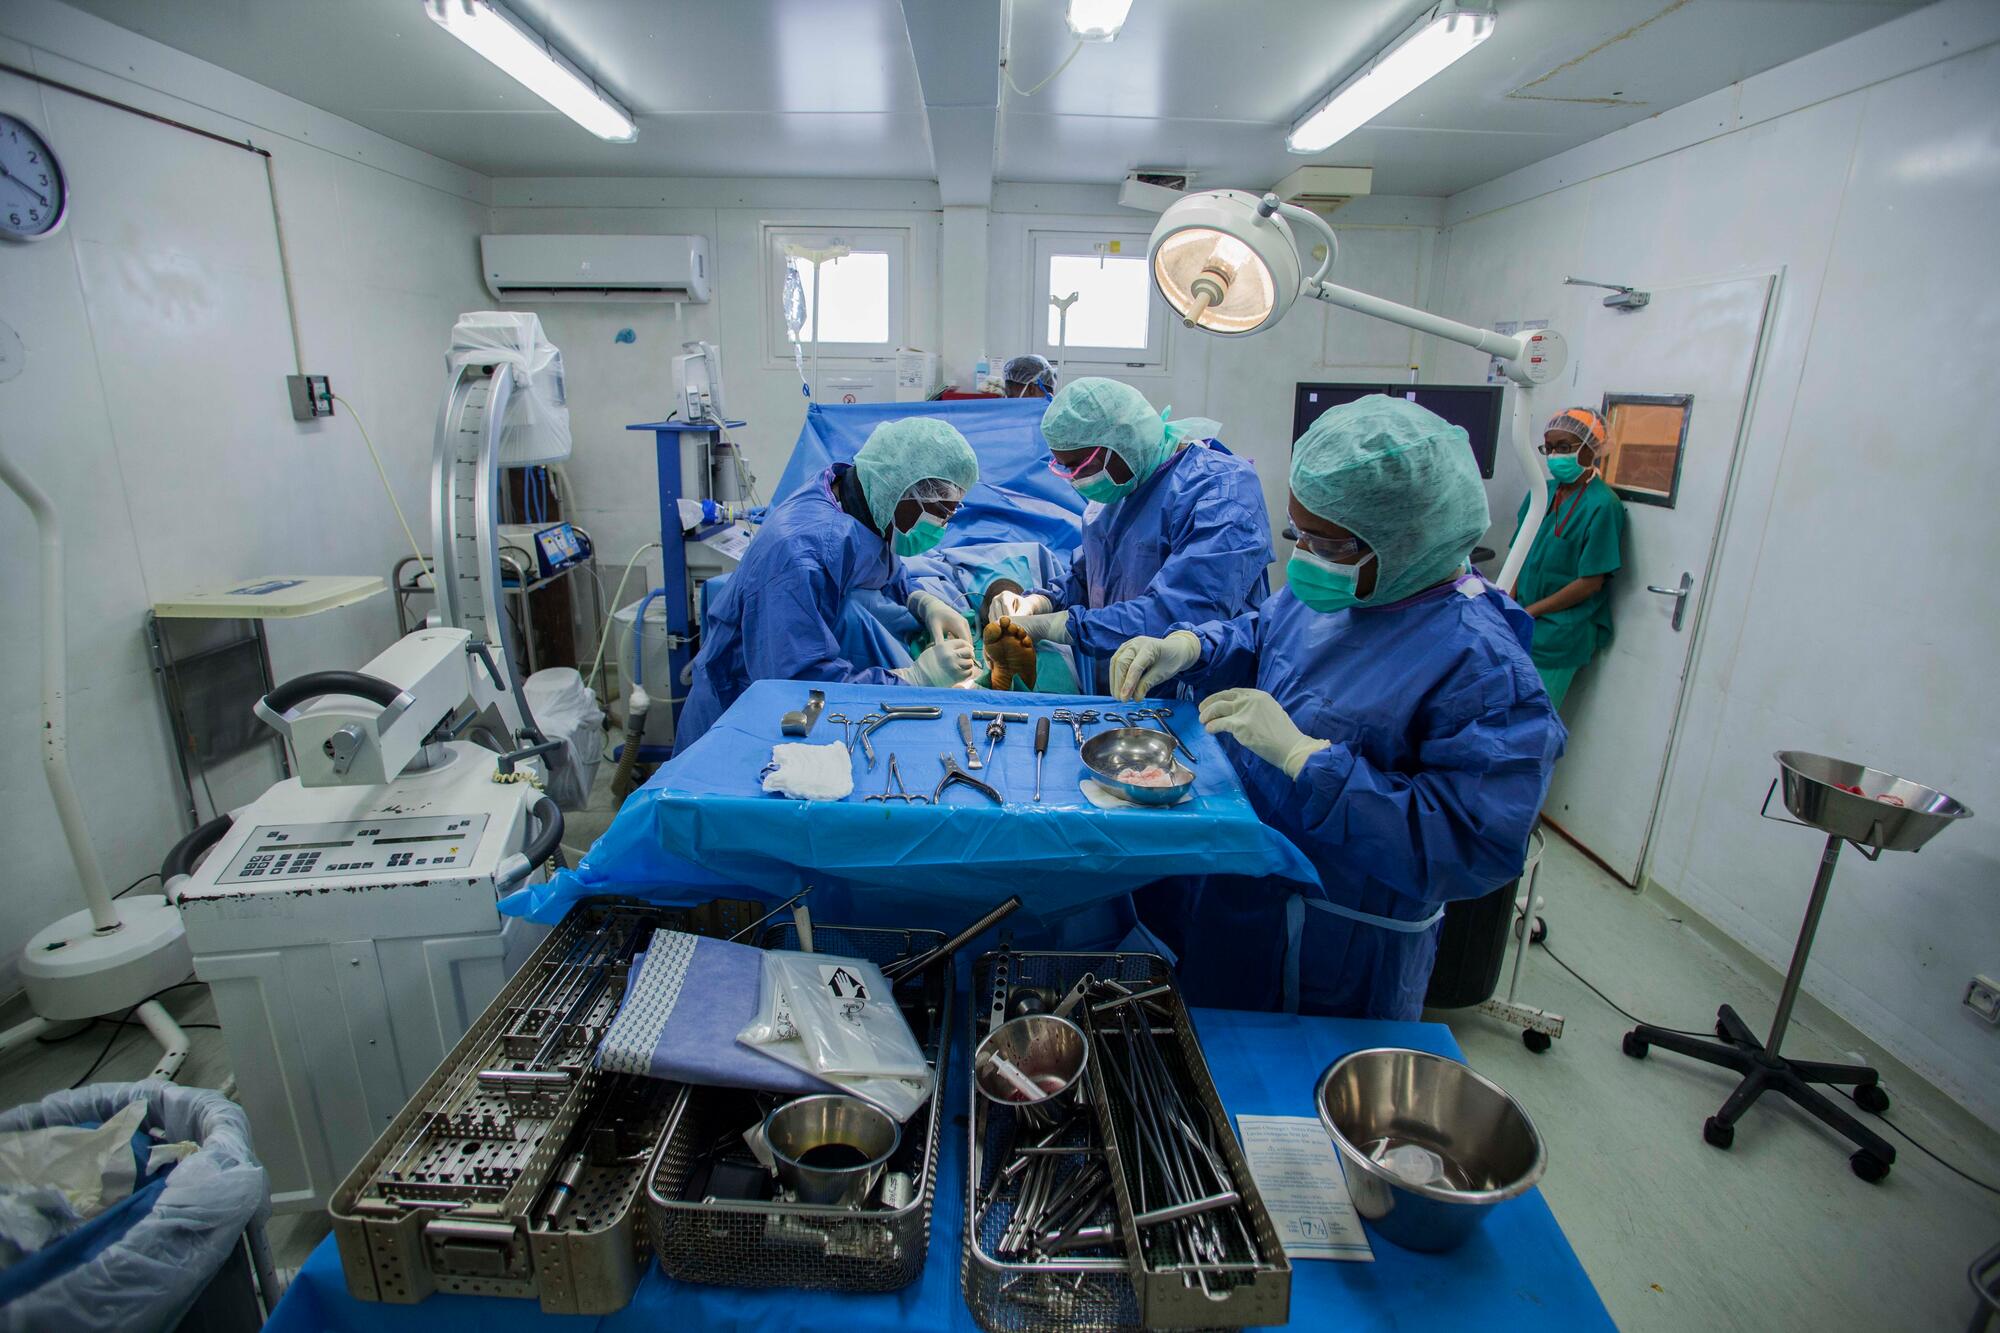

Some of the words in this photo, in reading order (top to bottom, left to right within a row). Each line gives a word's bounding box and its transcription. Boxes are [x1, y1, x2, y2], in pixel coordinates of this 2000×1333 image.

[11, 131, 18, 144] 1
[27, 151, 39, 164] 2
[38, 174, 48, 186] 3
[10, 213, 21, 225] 6
[29, 208, 39, 221] 5
